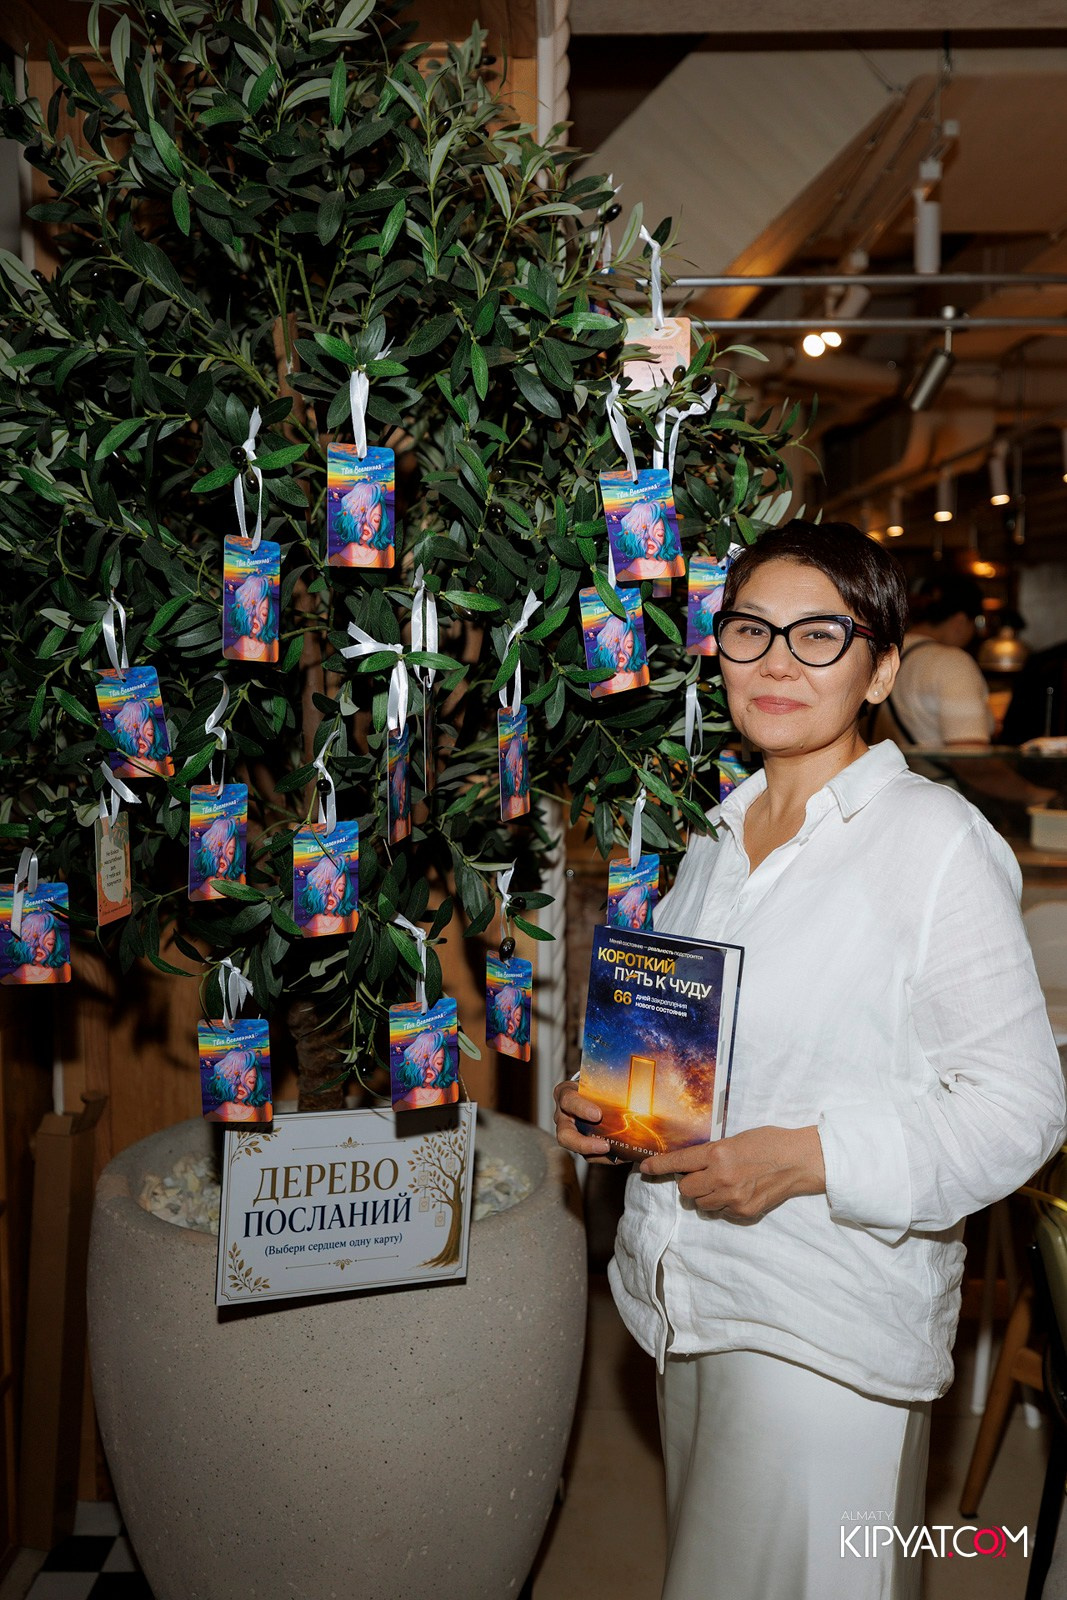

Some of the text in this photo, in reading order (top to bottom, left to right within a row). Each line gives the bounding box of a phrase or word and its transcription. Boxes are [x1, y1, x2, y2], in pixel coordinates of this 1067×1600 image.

[598, 947, 676, 975] КОРОТКИЙ
[613, 989, 632, 1005] 66
[614, 966, 712, 1000] ПУТЬ К ЧУДУ
[635, 1001, 688, 1018] нового состояния
[252, 1158, 399, 1207] ДЕРЕВО
[243, 1192, 412, 1238] ПОСЛАНИЙ
[264, 1232, 403, 1257] (Выбери сердцем одну карту)
